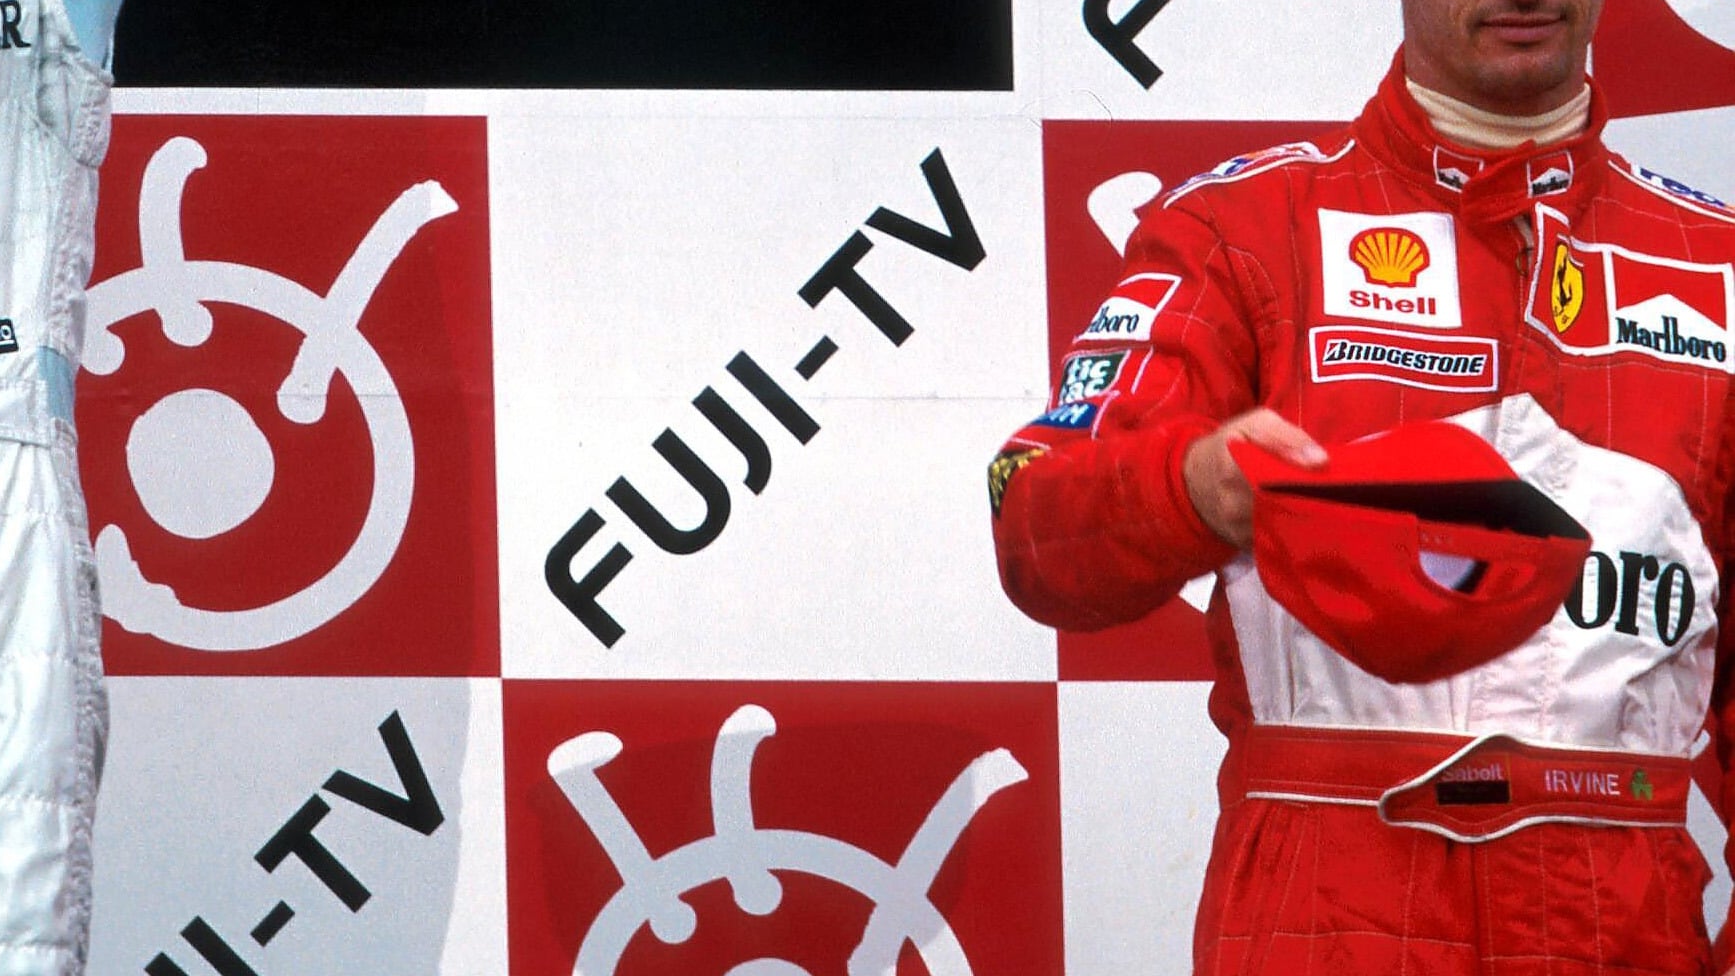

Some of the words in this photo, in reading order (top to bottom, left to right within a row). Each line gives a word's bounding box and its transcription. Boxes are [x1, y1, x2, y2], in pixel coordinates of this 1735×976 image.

[1349, 290, 1436, 316] Shell
[1615, 316, 1727, 363] Marlboro
[1322, 340, 1485, 376] BRIDGESTONE
[544, 147, 987, 650] FUJI-TV
[1544, 769, 1621, 796] IRVINE
